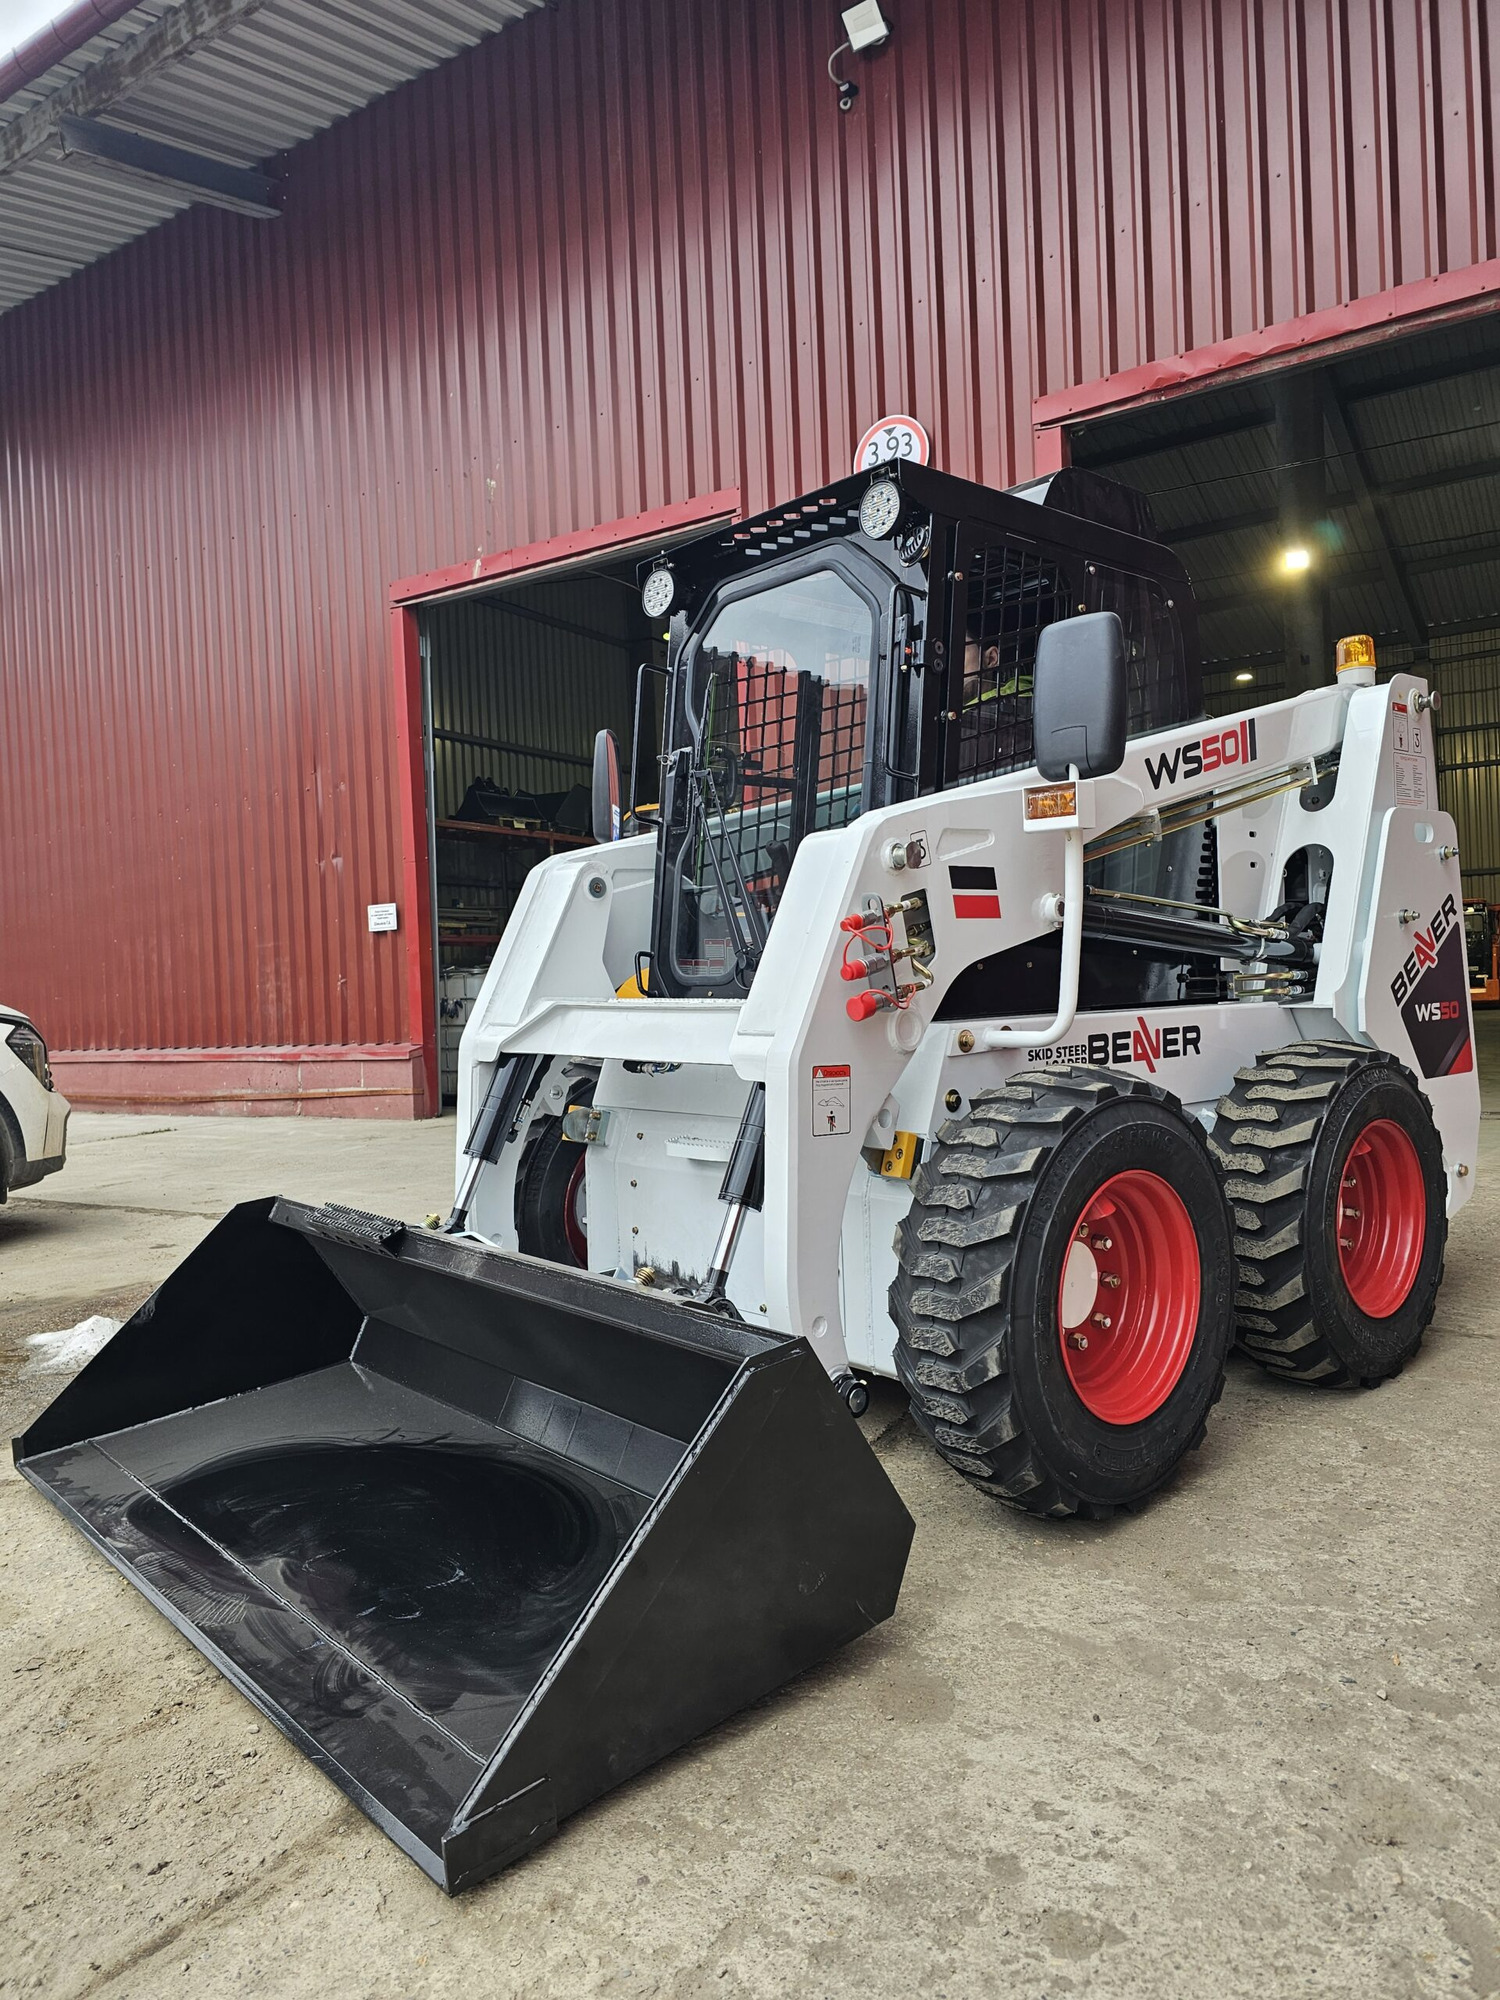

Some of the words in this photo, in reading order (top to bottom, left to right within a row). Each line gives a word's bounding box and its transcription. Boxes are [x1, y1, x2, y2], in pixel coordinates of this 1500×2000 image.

[1390, 893, 1457, 1008] BEAVER
[1415, 1001, 1460, 1022] WS50
[1027, 1047, 1053, 1062] SKID
[1055, 1044, 1087, 1059] STEER
[1087, 1016, 1201, 1073] BEAVER
